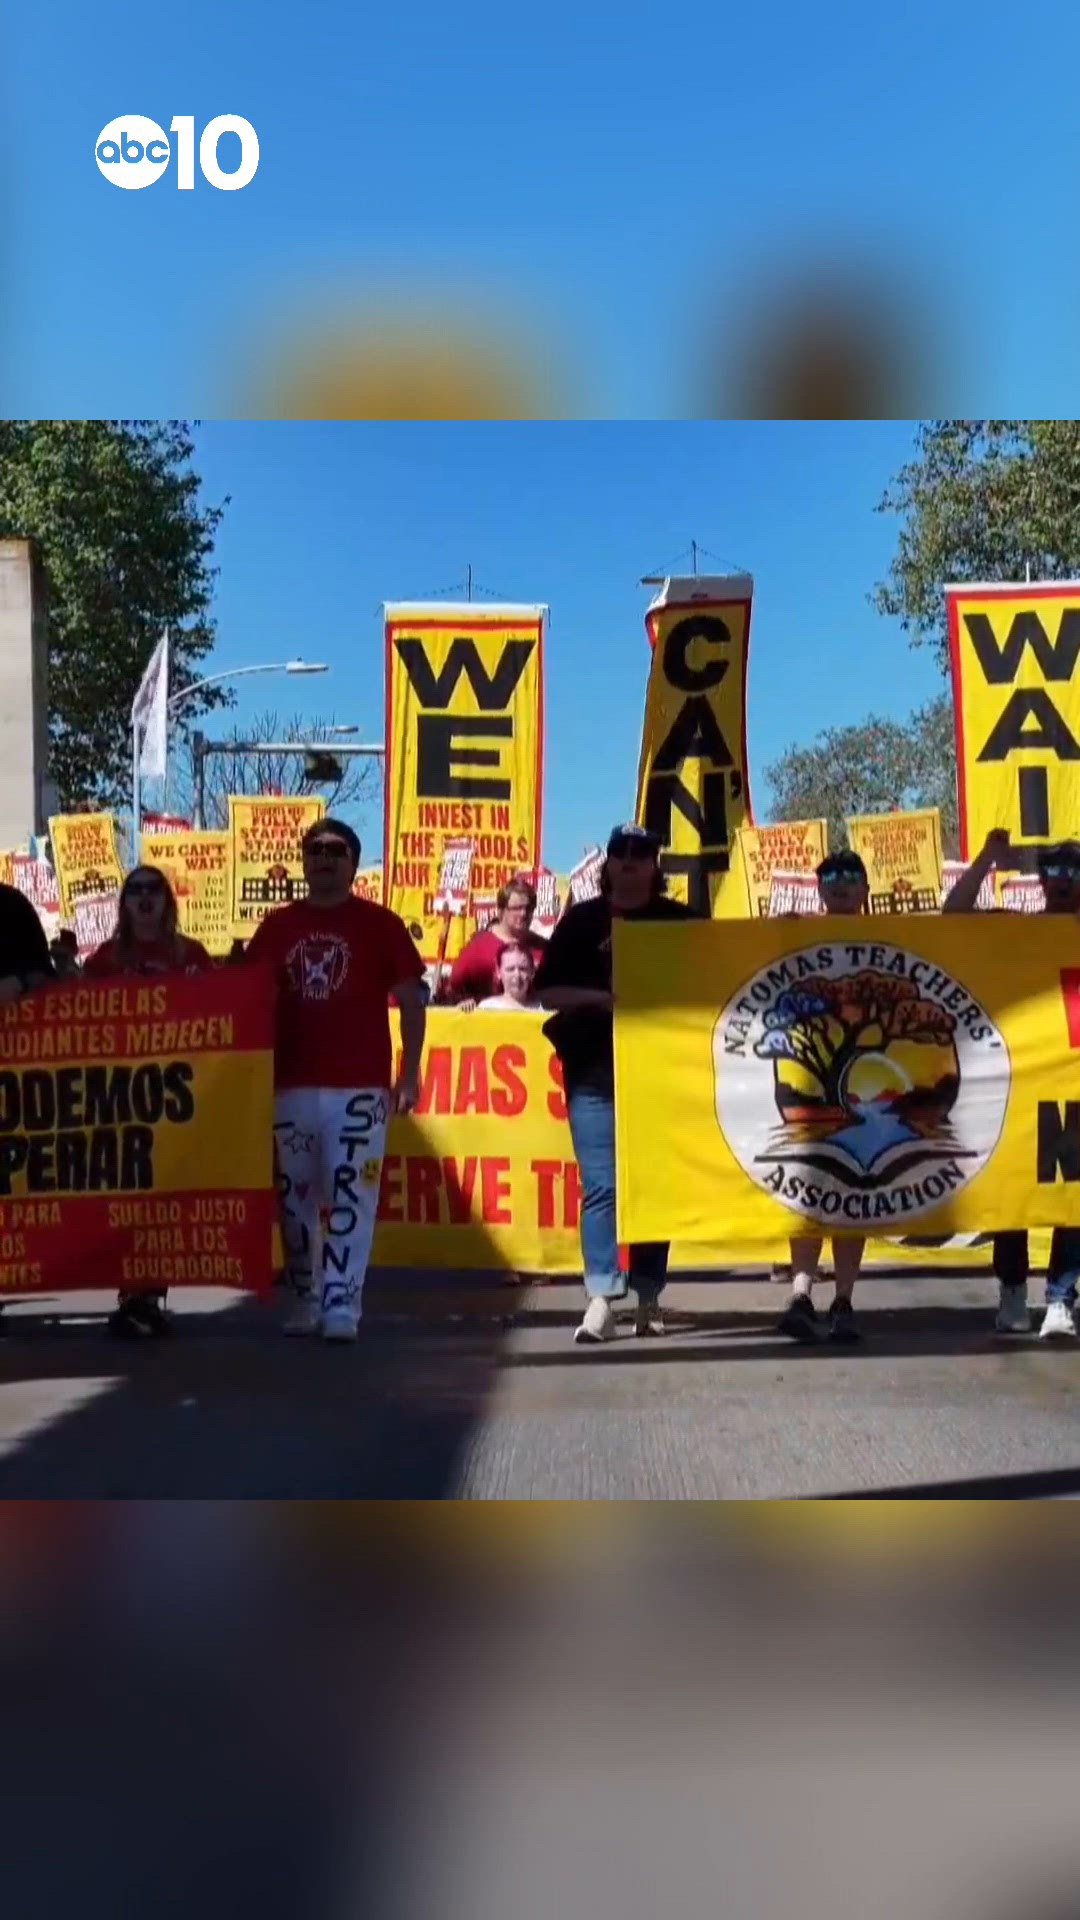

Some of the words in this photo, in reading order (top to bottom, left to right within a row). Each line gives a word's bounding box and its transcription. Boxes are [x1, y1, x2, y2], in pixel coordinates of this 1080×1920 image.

[394, 638, 536, 801] WE
[645, 616, 741, 918] CAN'T
[252, 814, 301, 826] FULLY
[418, 803, 484, 829] INVEST
[490, 804, 510, 830] IN
[149, 844, 175, 858] WE
[178, 844, 226, 858] CAN'T
[400, 832, 435, 858] THE
[185, 857, 226, 871] WAIT
[394, 861, 430, 889] OUR
[44, 985, 168, 1021] ESCUELAS
[724, 946, 834, 1058] NATOMAS
[845, 945, 1001, 1049] TEACHERS'
[126, 1014, 234, 1055] MERECEN
[402, 1043, 528, 1117] MAS
[763, 1161, 967, 1220] ASSOCIATION
[12, 1202, 62, 1229] PARA
[109, 1200, 182, 1228] SUELDO
[190, 1199, 247, 1223] JUSTO
[134, 1228, 184, 1252] PARA
[193, 1227, 228, 1251] LOS
[122, 1257, 244, 1282] EDUCADORES
